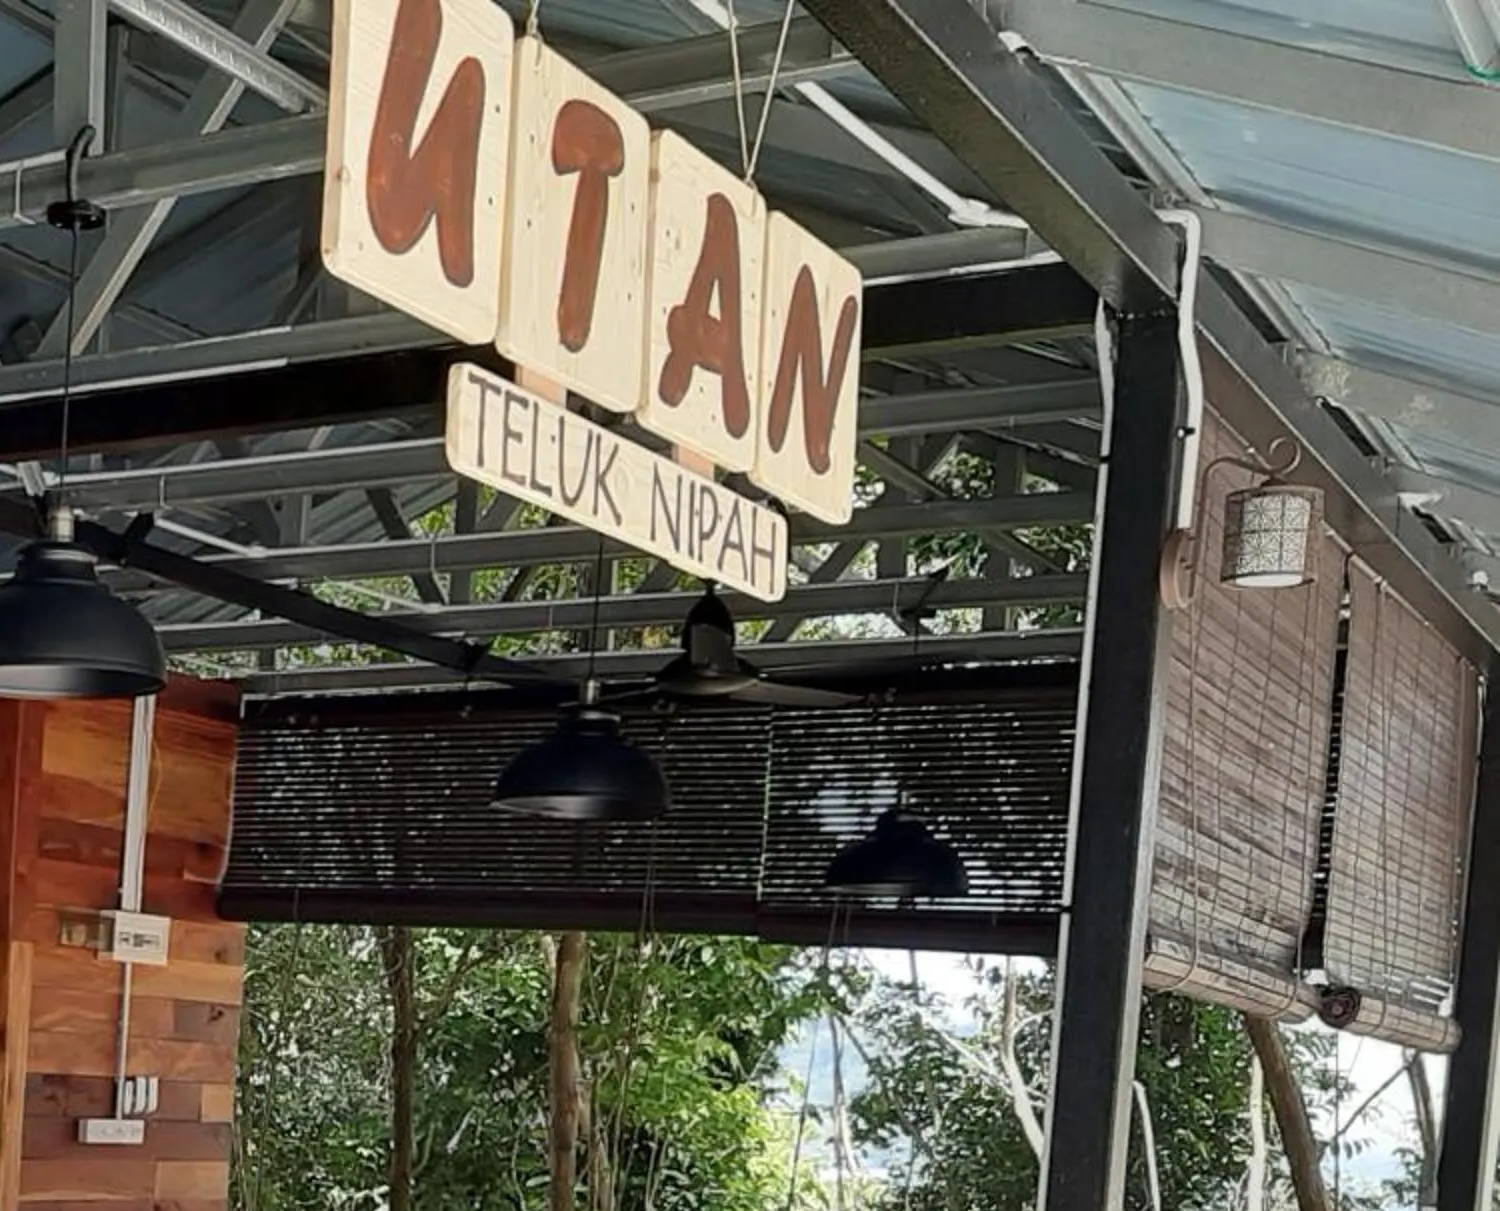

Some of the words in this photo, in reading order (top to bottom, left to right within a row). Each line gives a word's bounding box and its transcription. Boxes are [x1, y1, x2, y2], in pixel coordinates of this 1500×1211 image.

[366, 0, 858, 475] UTAN
[468, 371, 623, 527] TELUK
[650, 461, 777, 595] NIPAH
